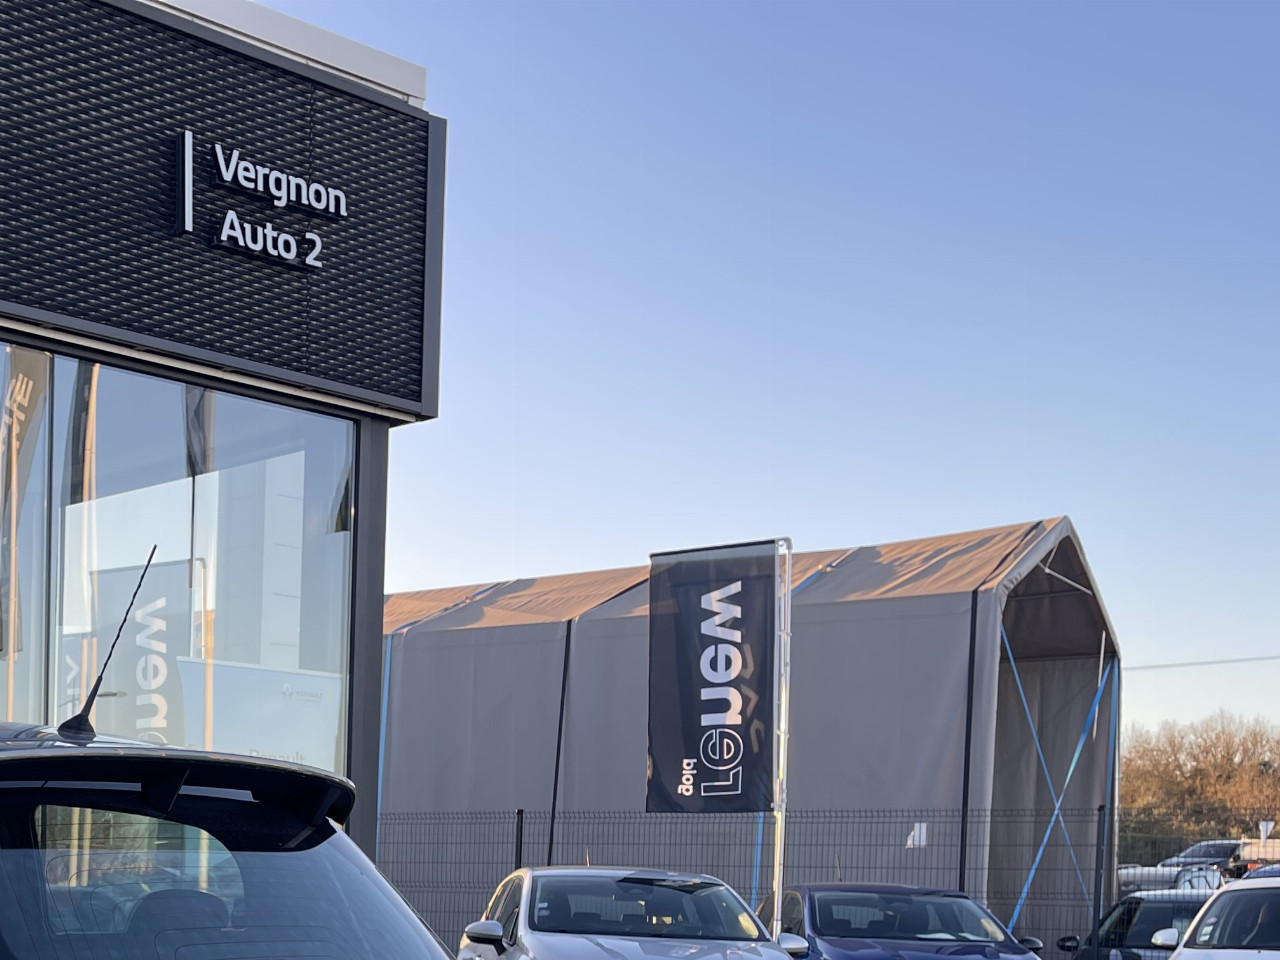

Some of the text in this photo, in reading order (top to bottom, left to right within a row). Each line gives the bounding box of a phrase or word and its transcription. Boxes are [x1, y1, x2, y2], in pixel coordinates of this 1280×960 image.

[214, 143, 348, 217] Vergnon
[220, 209, 323, 267] Auto 2
